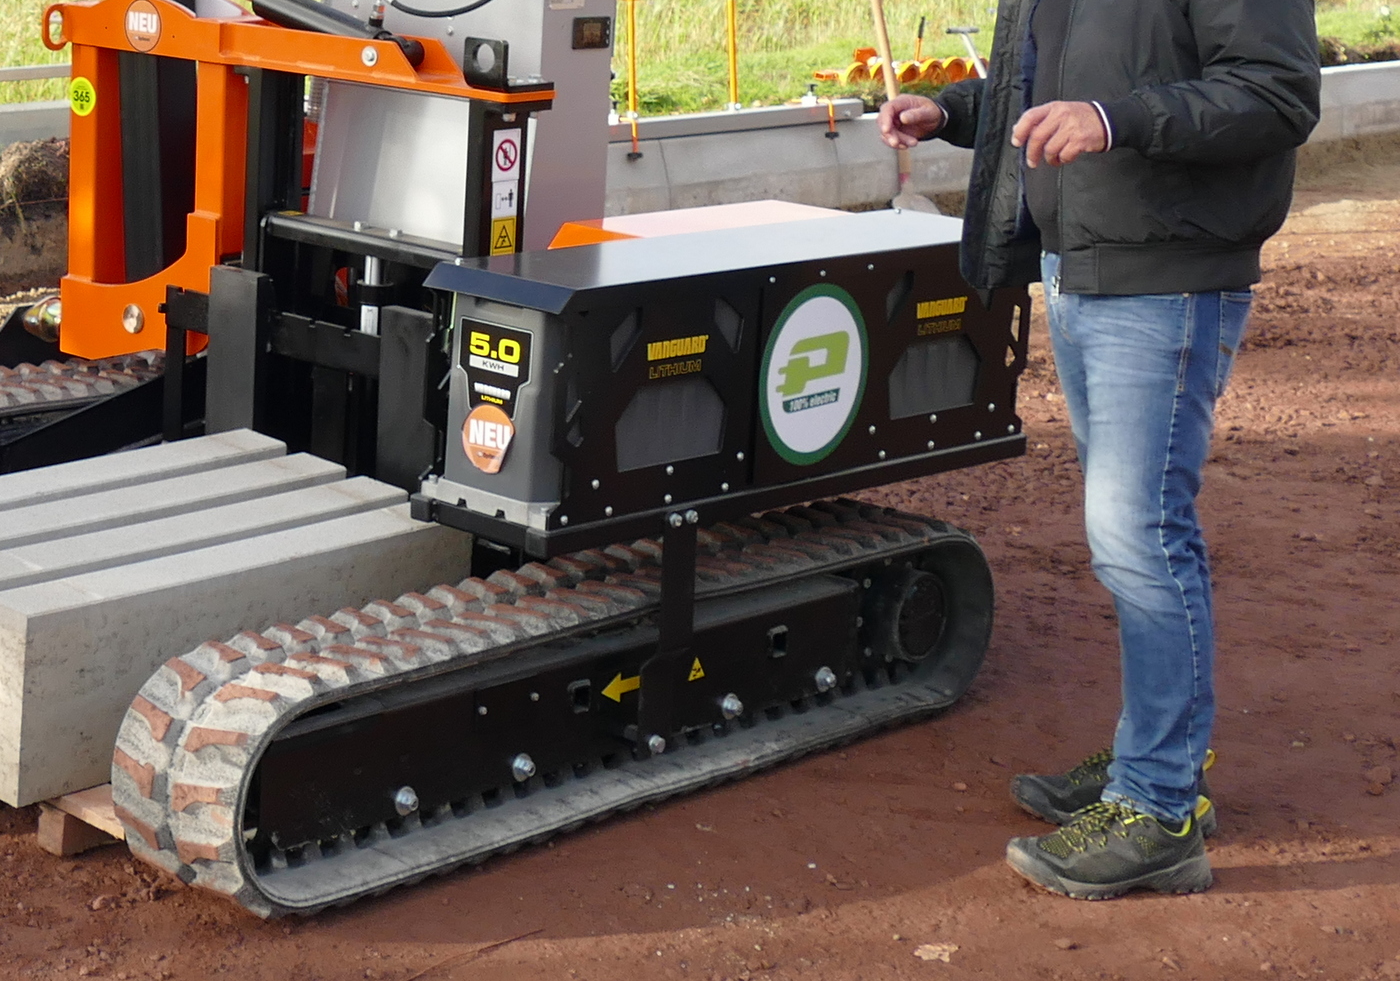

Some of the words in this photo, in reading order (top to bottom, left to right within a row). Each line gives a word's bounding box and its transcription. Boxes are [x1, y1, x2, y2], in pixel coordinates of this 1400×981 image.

[128, 11, 158, 33] NEU
[73, 90, 91, 103] 365
[469, 331, 521, 364] 5.0
[482, 361, 505, 372] KWH
[649, 359, 702, 379] LITHIUM
[790, 397, 809, 412] 100%
[809, 390, 837, 407] electric
[469, 419, 511, 451] NEU
